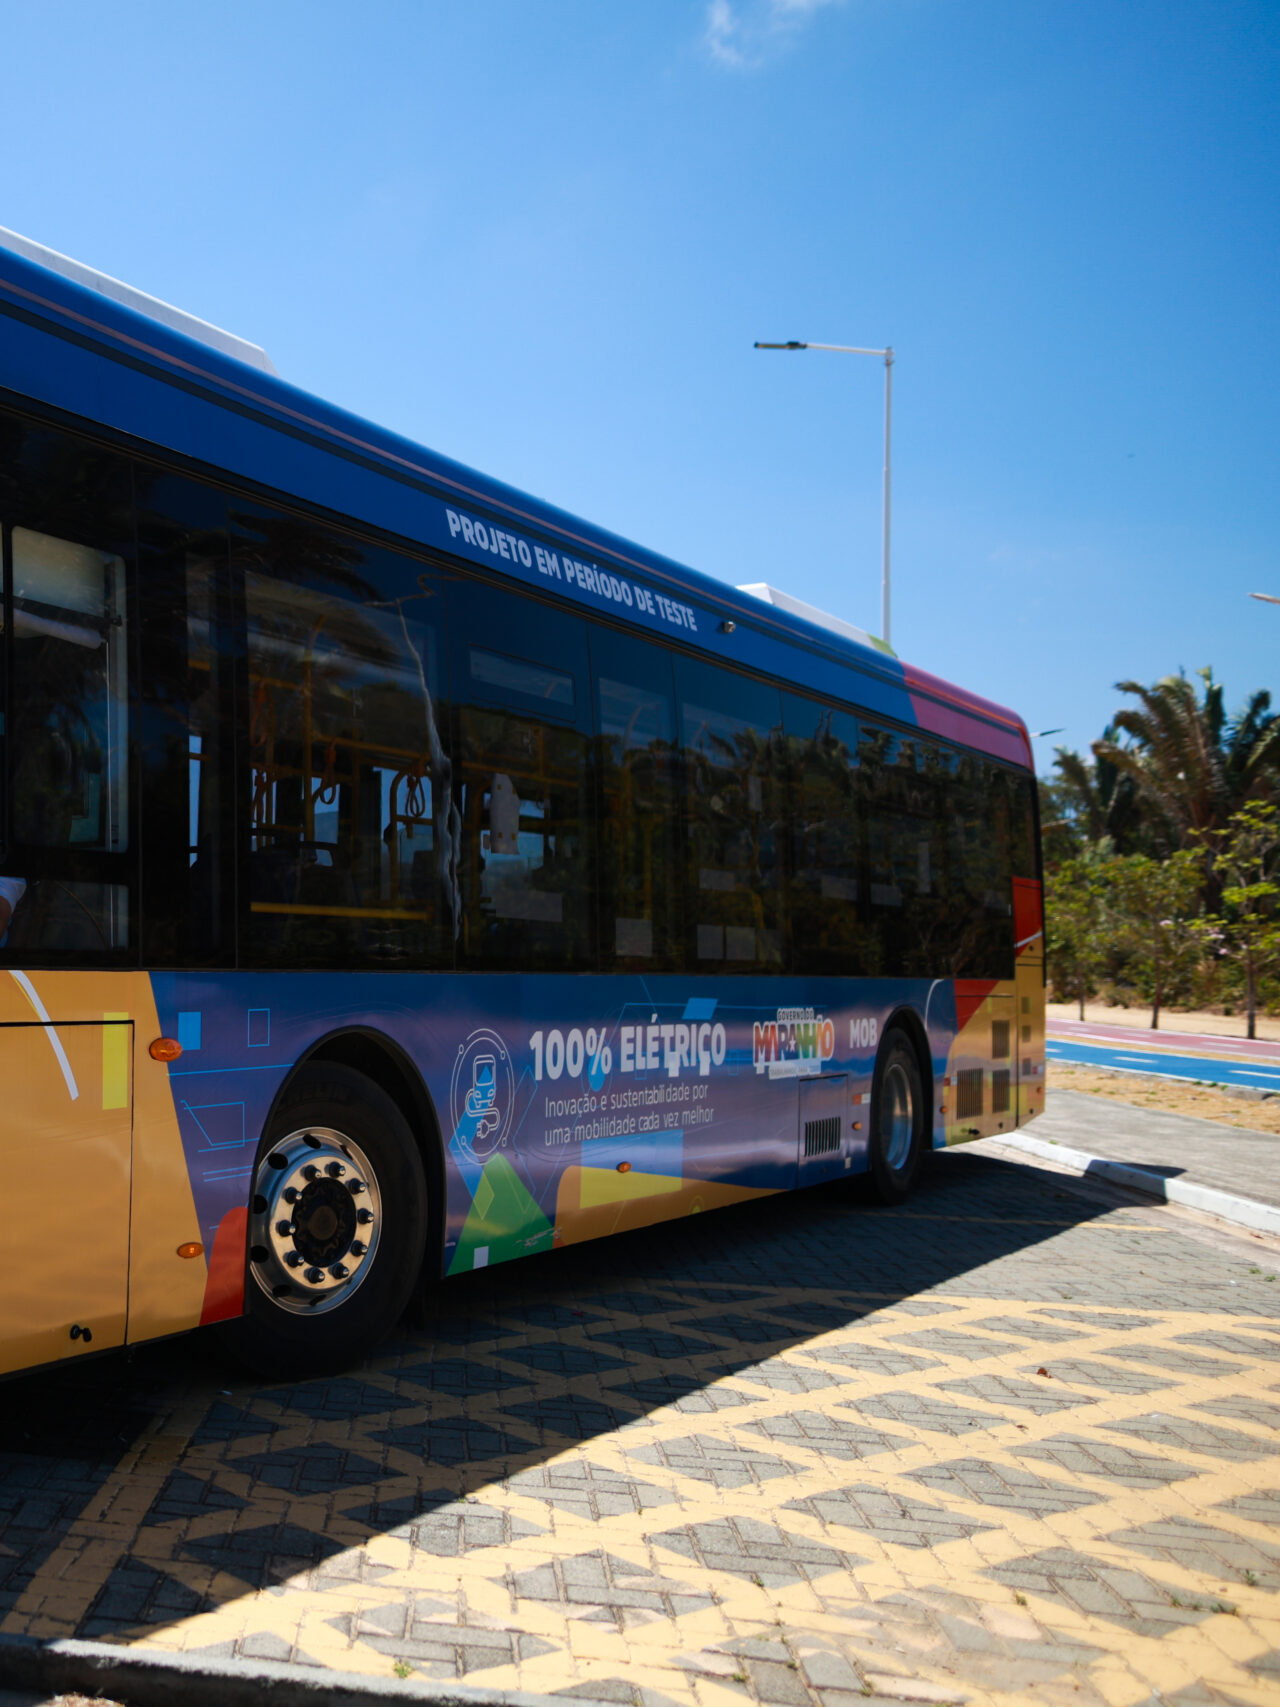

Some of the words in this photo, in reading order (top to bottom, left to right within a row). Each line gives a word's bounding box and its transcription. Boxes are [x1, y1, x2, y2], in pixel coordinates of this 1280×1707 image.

[445, 509, 532, 568] PROJETO
[533, 545, 561, 580] EM
[562, 557, 634, 607] PERÍODO
[634, 586, 656, 616] DE
[655, 596, 698, 632] TESTE
[529, 1027, 612, 1081] 100%
[620, 1013, 726, 1073] ELÉTRICO
[849, 1018, 878, 1049] MOB
[545, 1093, 597, 1118] Inovação
[600, 1095, 607, 1111] e
[610, 1083, 689, 1110] sustentabilidade
[692, 1084, 708, 1102] por
[544, 1127, 570, 1146] uma
[574, 1113, 635, 1142] mobilidade
[638, 1112, 659, 1132] cada
[663, 1112, 679, 1128] vez
[681, 1105, 714, 1126] melhor
